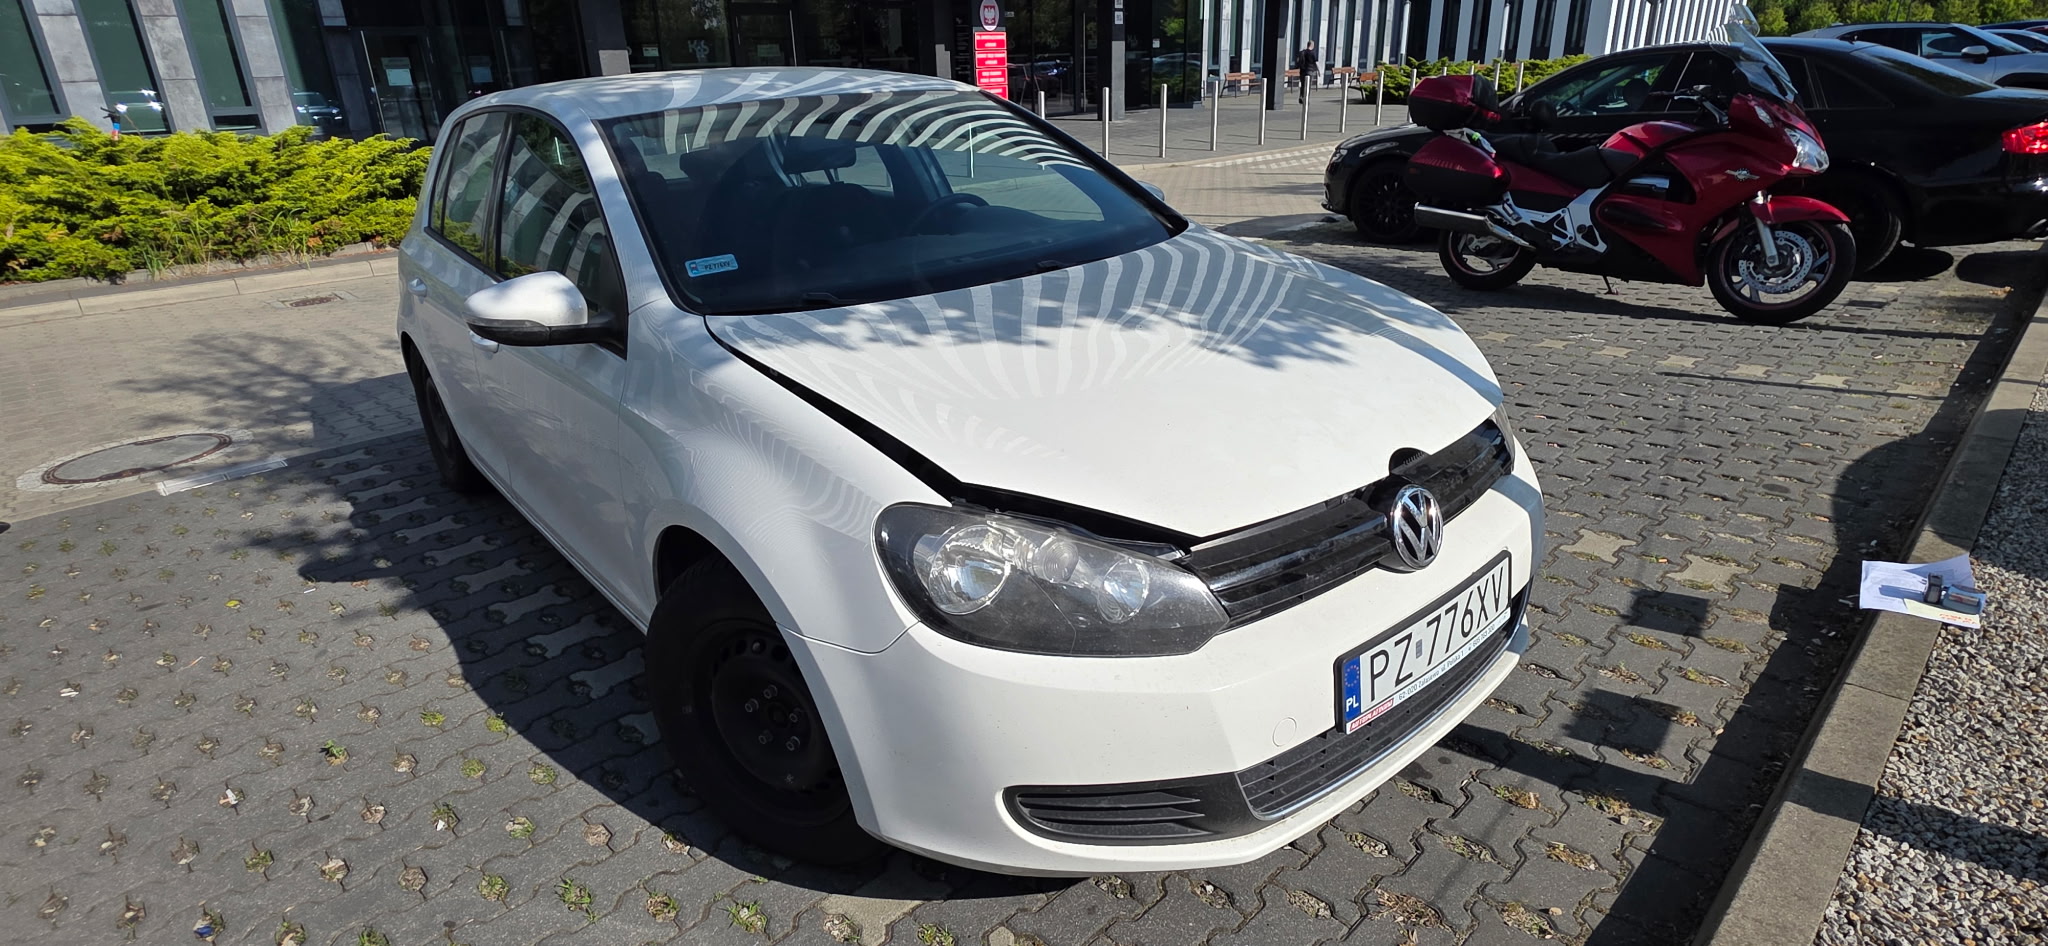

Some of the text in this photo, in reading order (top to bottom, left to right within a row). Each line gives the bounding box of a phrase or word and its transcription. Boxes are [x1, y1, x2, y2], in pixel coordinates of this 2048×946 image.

[1370, 566, 1504, 702] PZ 776XV
[1345, 695, 1360, 713] PL
